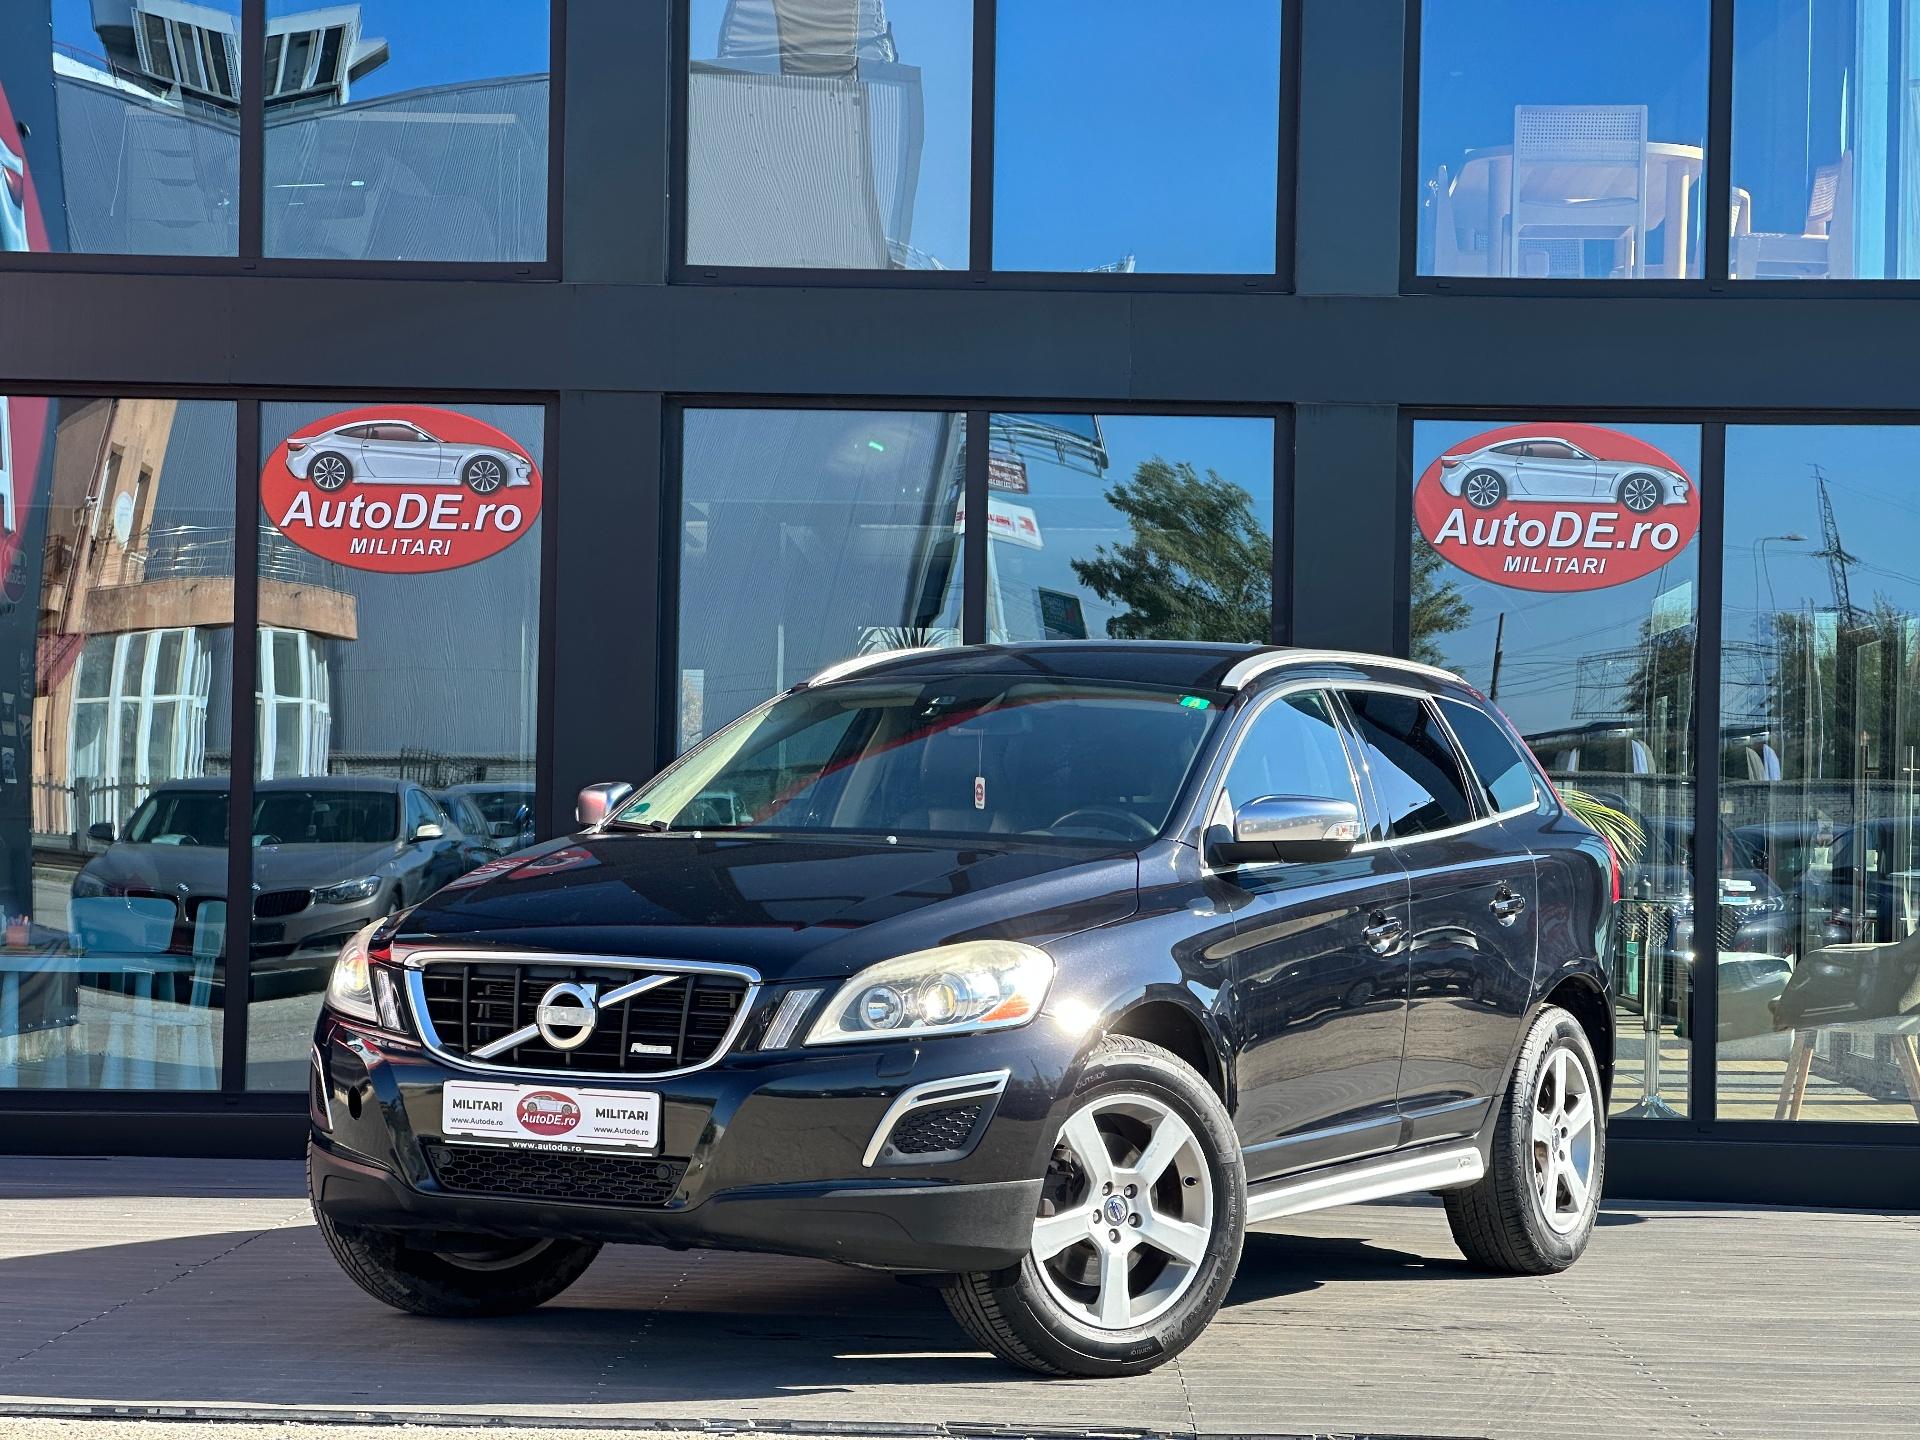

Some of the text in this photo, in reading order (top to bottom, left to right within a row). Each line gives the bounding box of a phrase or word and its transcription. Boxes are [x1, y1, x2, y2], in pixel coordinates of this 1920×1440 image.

[280, 490, 524, 532] AutoDE.ro
[1433, 508, 1680, 551] AutoDE.ro
[349, 537, 452, 556] MILITARI
[1503, 555, 1607, 575] MILITARI
[452, 1098, 503, 1112] MILITARI
[451, 1116, 504, 1126] www.Autode.ro
[521, 1112, 576, 1127] AutoDE.ro
[595, 1107, 648, 1121] MILITARI
[593, 1125, 649, 1136] www.Autode.ro
[511, 1140, 582, 1152] www.autode.ro
